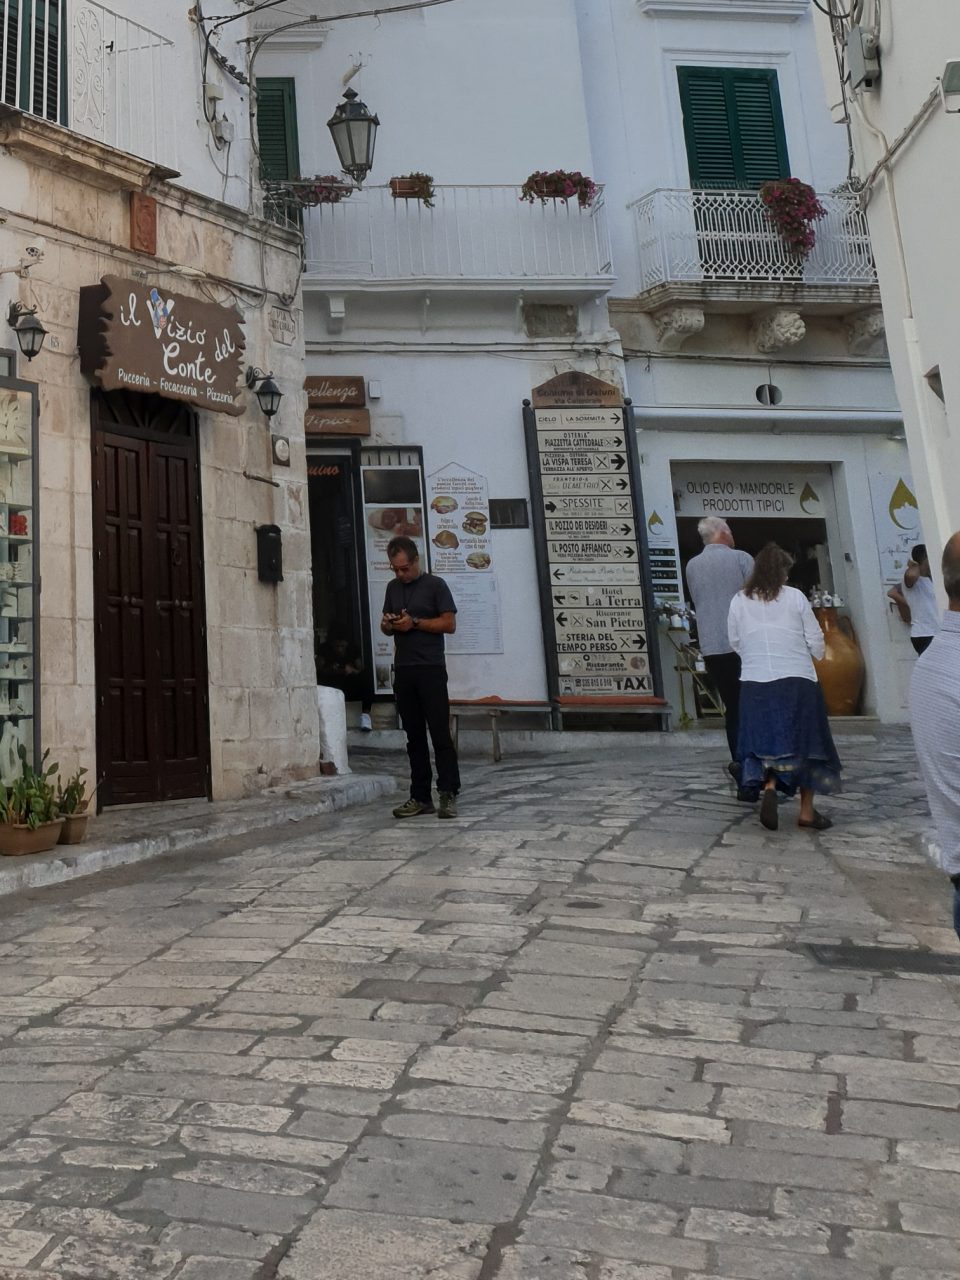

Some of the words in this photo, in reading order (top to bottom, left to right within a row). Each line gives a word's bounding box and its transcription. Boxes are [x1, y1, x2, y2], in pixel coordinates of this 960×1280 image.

[120, 293, 141, 326] il
[146, 291, 206, 345] Vizio
[215, 328, 235, 362] del
[162, 342, 216, 383] Conte
[118, 368, 150, 387] Pucceria
[160, 378, 197, 396] Focacceria
[206, 387, 233, 403] Pizzeria
[542, 458, 551, 466] LA
[552, 458, 570, 466] VISPA
[571, 458, 593, 466] TERESA
[686, 481, 710, 494] OLIO
[713, 481, 734, 495] EVO
[740, 482, 796, 495] MANDORLE
[702, 498, 753, 511] PRODOTTI
[756, 499, 785, 512] TIPICI
[555, 521, 573, 530] POZZO
[574, 521, 584, 530] DEI
[584, 521, 608, 530] DESIDERI
[552, 543, 558, 552] IL
[559, 543, 579, 552] POSTO
[581, 543, 612, 552] AFFIANCO
[585, 595, 602, 606] La
[605, 595, 641, 606] Terra
[585, 617, 607, 628] San
[610, 617, 644, 628] Pietro
[563, 633, 596, 641] STERIA
[598, 633, 615, 641] DEL
[557, 643, 587, 651] TEMPO
[589, 643, 618, 651] PERSO
[613, 677, 653, 690] TAXI
